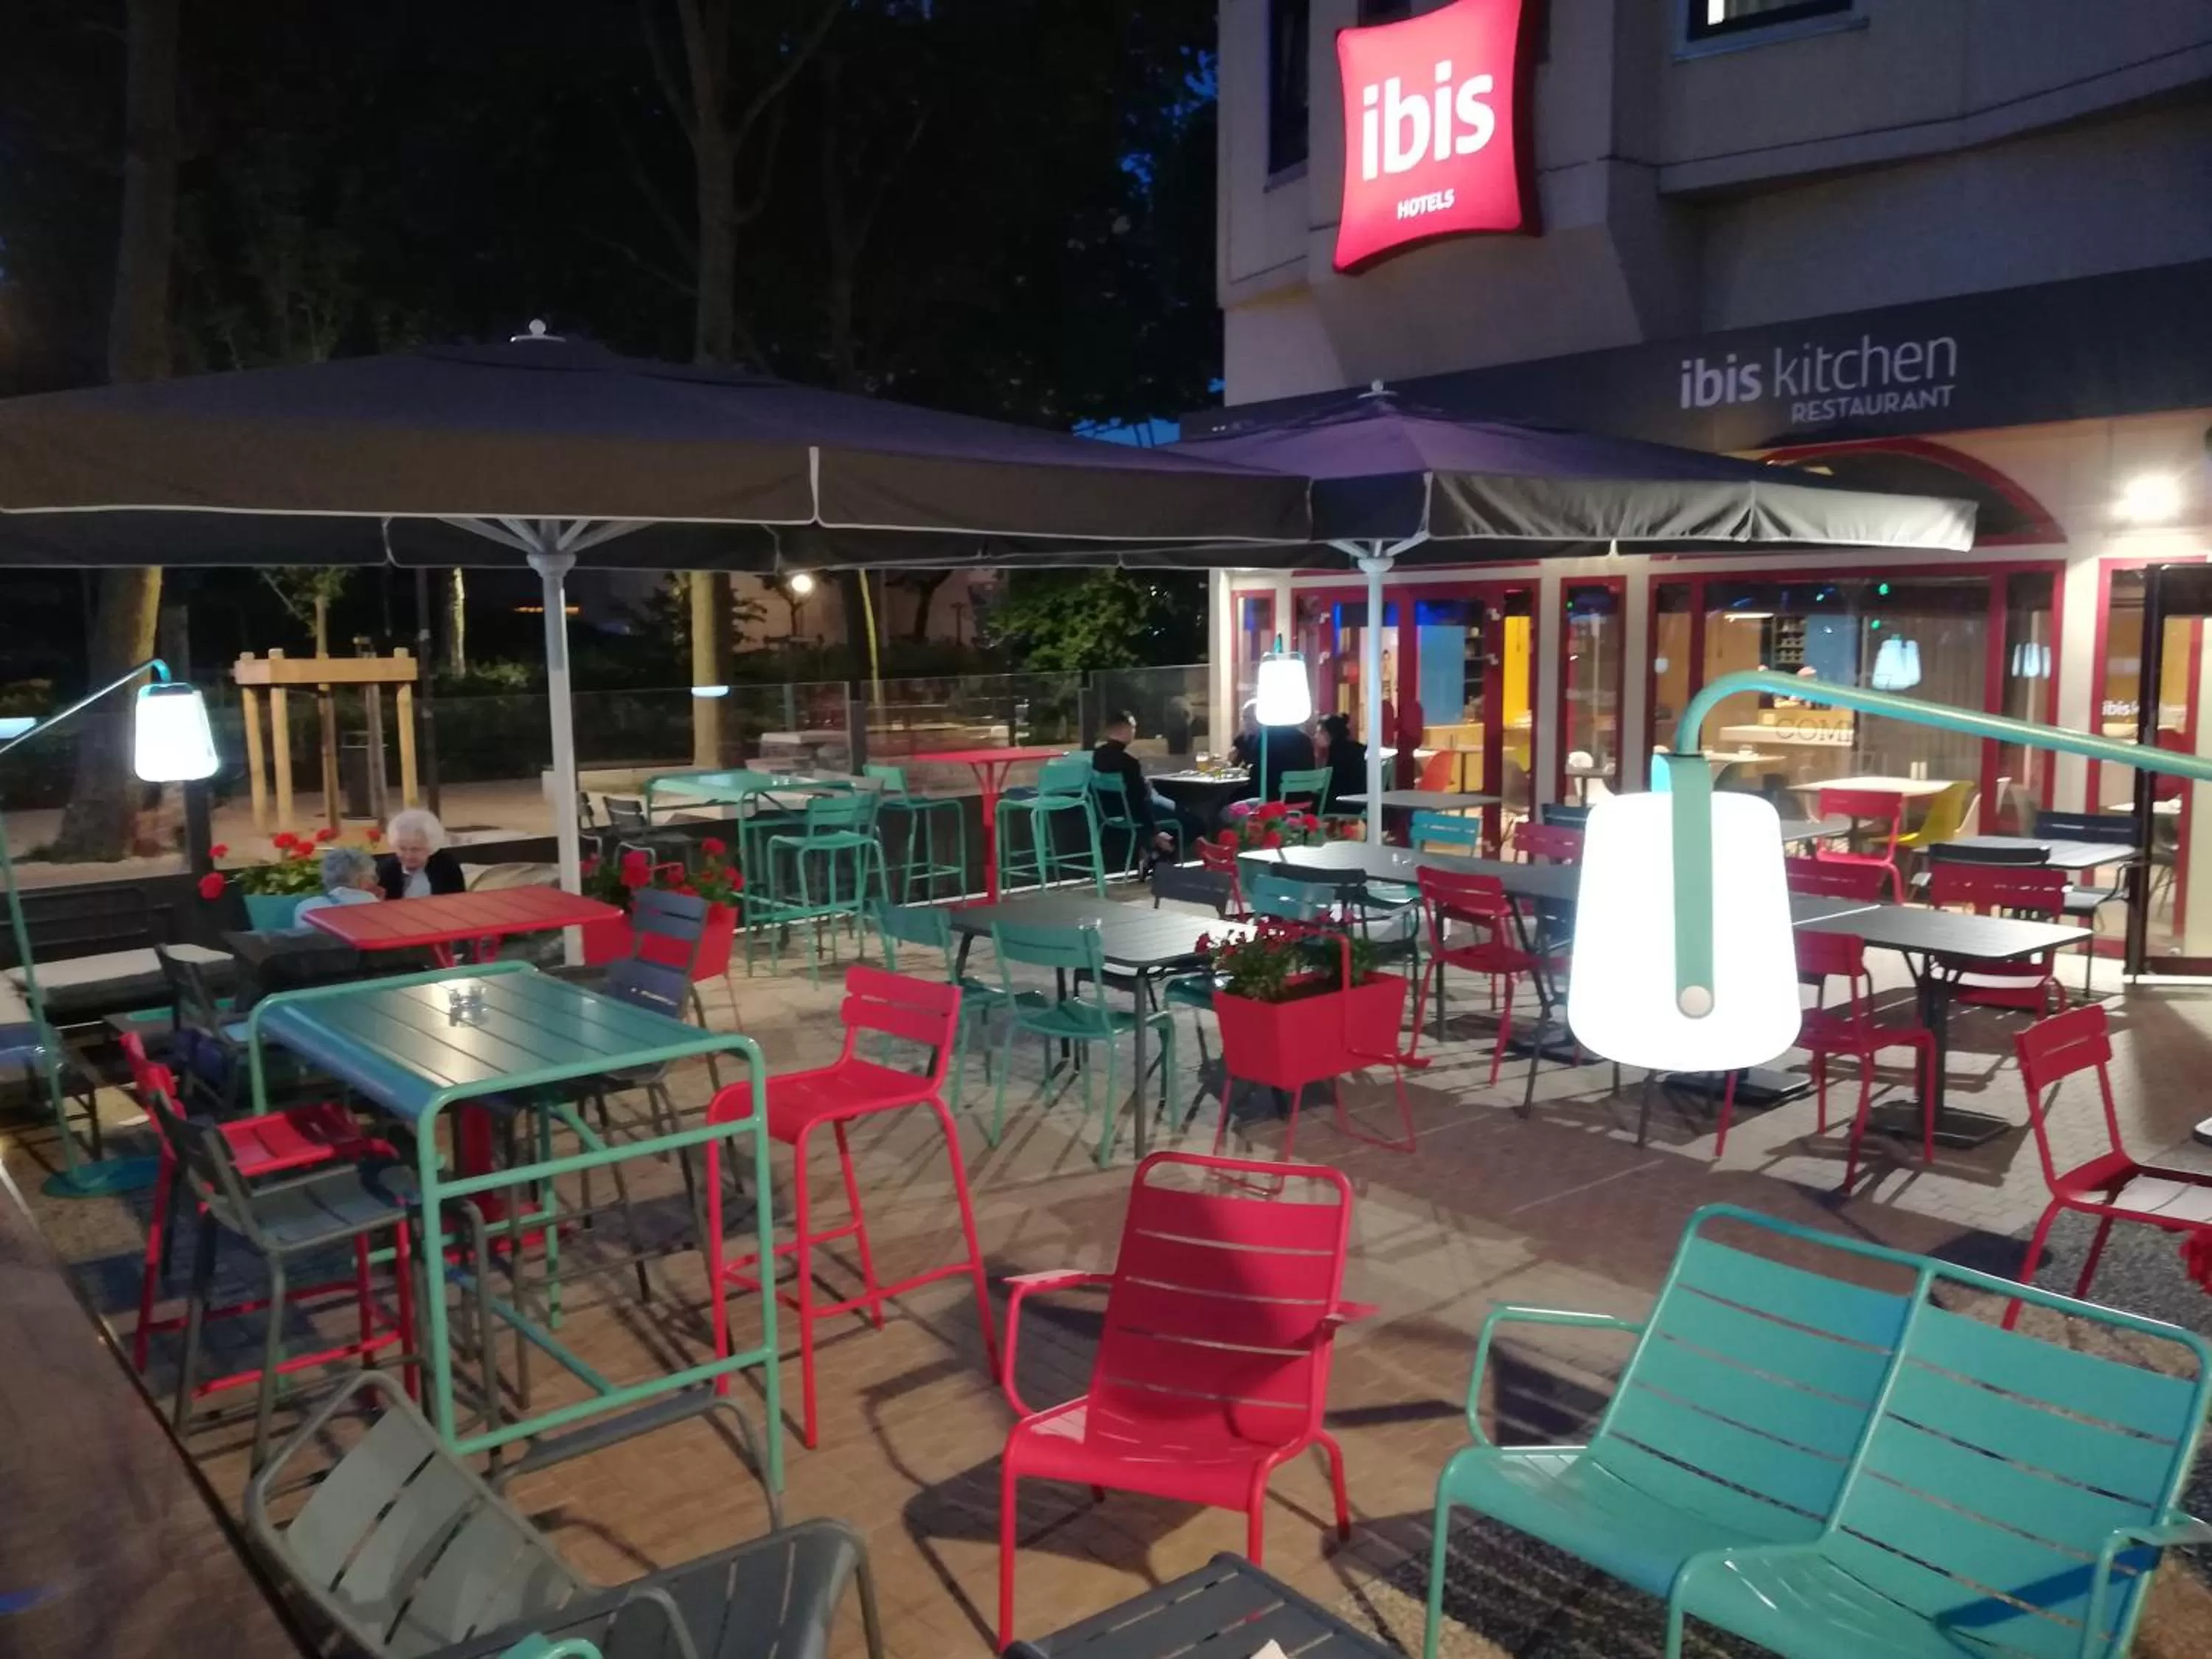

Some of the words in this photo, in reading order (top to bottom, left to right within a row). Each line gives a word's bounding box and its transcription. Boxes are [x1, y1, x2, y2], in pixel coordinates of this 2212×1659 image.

[1362, 59, 1495, 182] ibis
[1397, 188, 1455, 220] HOTELS
[1680, 353, 1763, 410] ibis
[1773, 334, 1958, 398] kitchen
[1791, 384, 1956, 425] RESTAURANT
